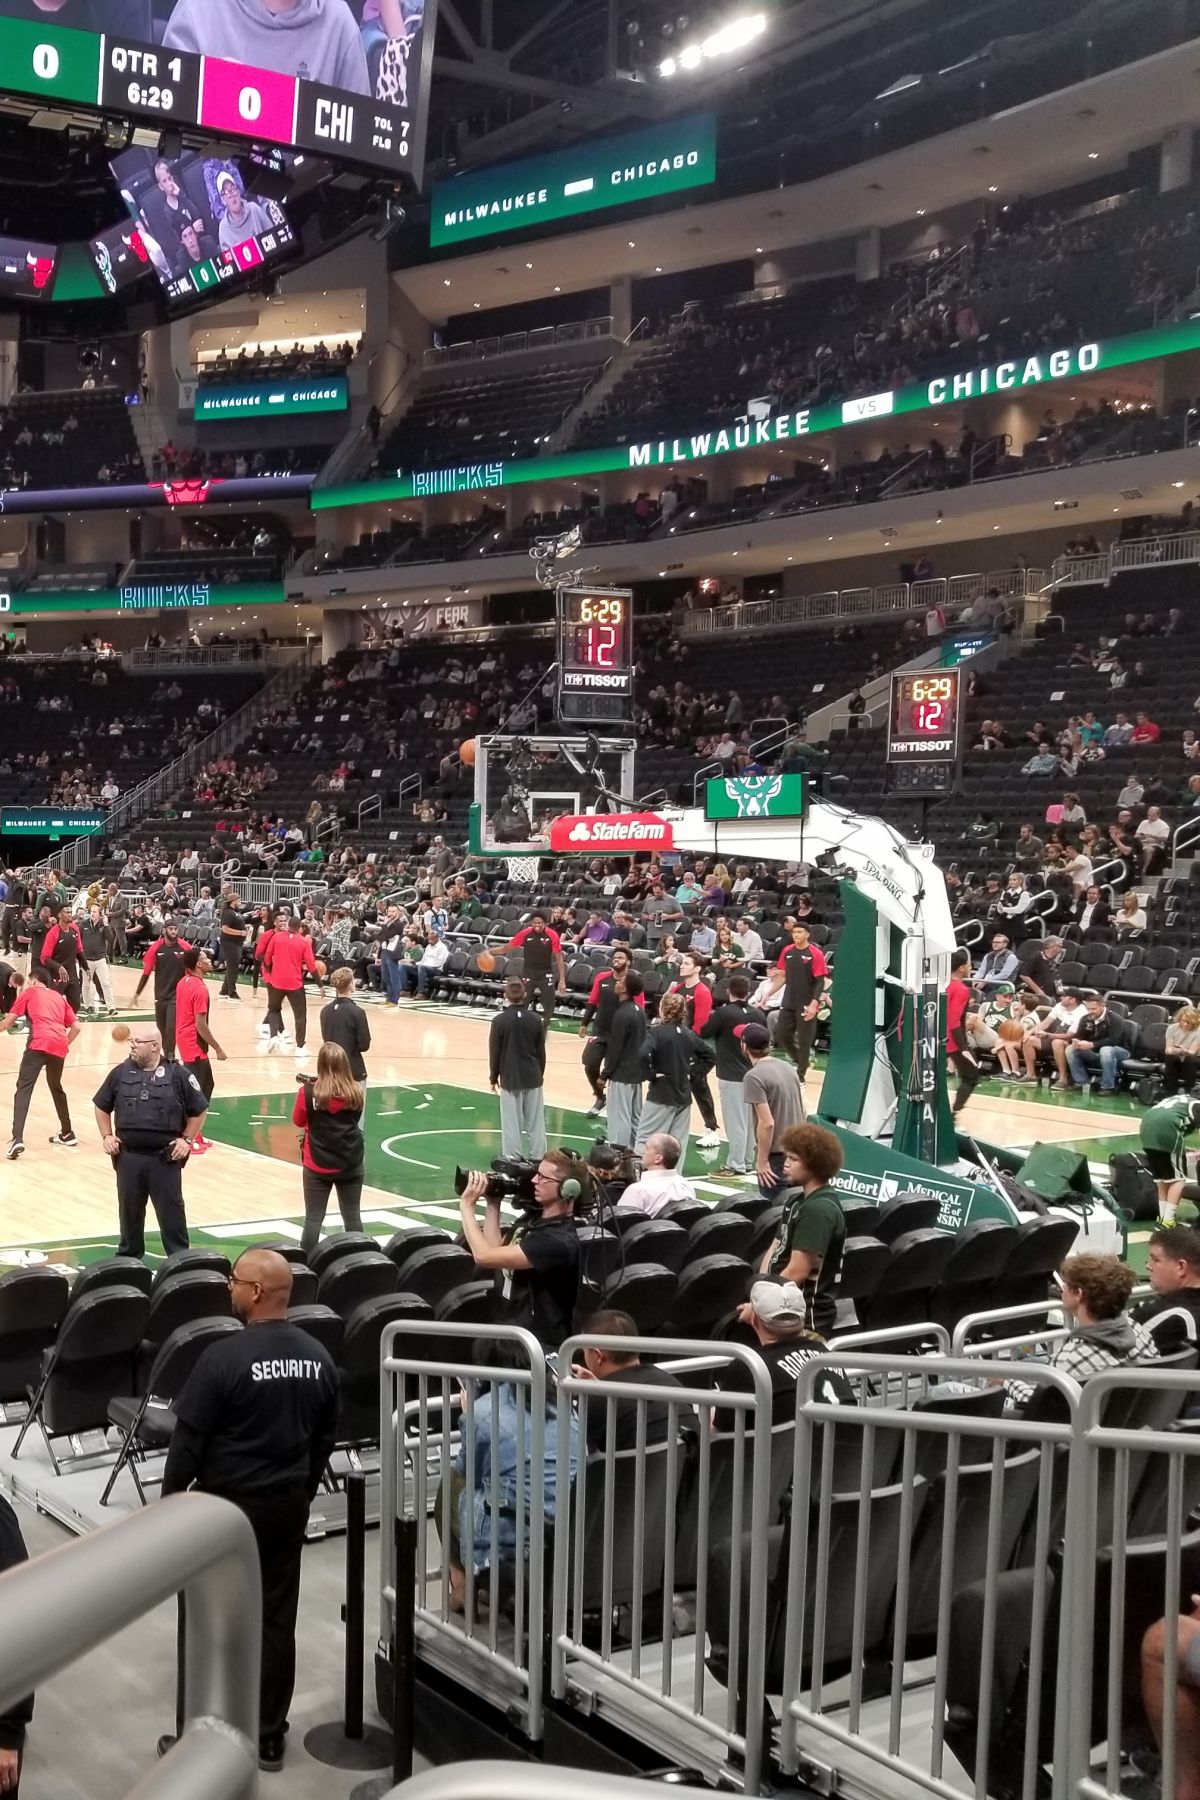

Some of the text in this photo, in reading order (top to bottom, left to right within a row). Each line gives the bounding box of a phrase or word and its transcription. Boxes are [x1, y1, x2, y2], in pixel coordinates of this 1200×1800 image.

[32, 44, 60, 79] 0
[112, 47, 181, 81] QTR 1
[127, 84, 174, 110] 6:29
[238, 87, 262, 120] 0
[315, 99, 353, 143] CHI
[374, 115, 410, 137] TOL 7
[399, 140, 409, 157] 0
[611, 151, 698, 185] CHICAGO
[444, 189, 548, 226] MILWAUKEE
[242, 246, 252, 262] 0
[200, 267, 209, 282] 0
[928, 344, 1099, 406] CHICAGO
[203, 395, 261, 409] MILWAUKEE
[292, 389, 338, 402] CHICAGO
[629, 401, 878, 467] MILWAUKEE VS
[411, 463, 504, 497] BUCKS
[121, 585, 209, 608] BUCKS
[436, 606, 469, 625] FEAR
[581, 598, 621, 624] 6:29
[588, 626, 615, 665] 12
[583, 675, 628, 687] TISSOT
[913, 678, 951, 702] 6:29
[919, 702, 942, 730] 12
[907, 740, 953, 751] TISSOT
[863, 860, 904, 901] SPALDING
[907, 1182, 961, 1206] MEDICAL
[251, 1359, 322, 1382] SECURITY
